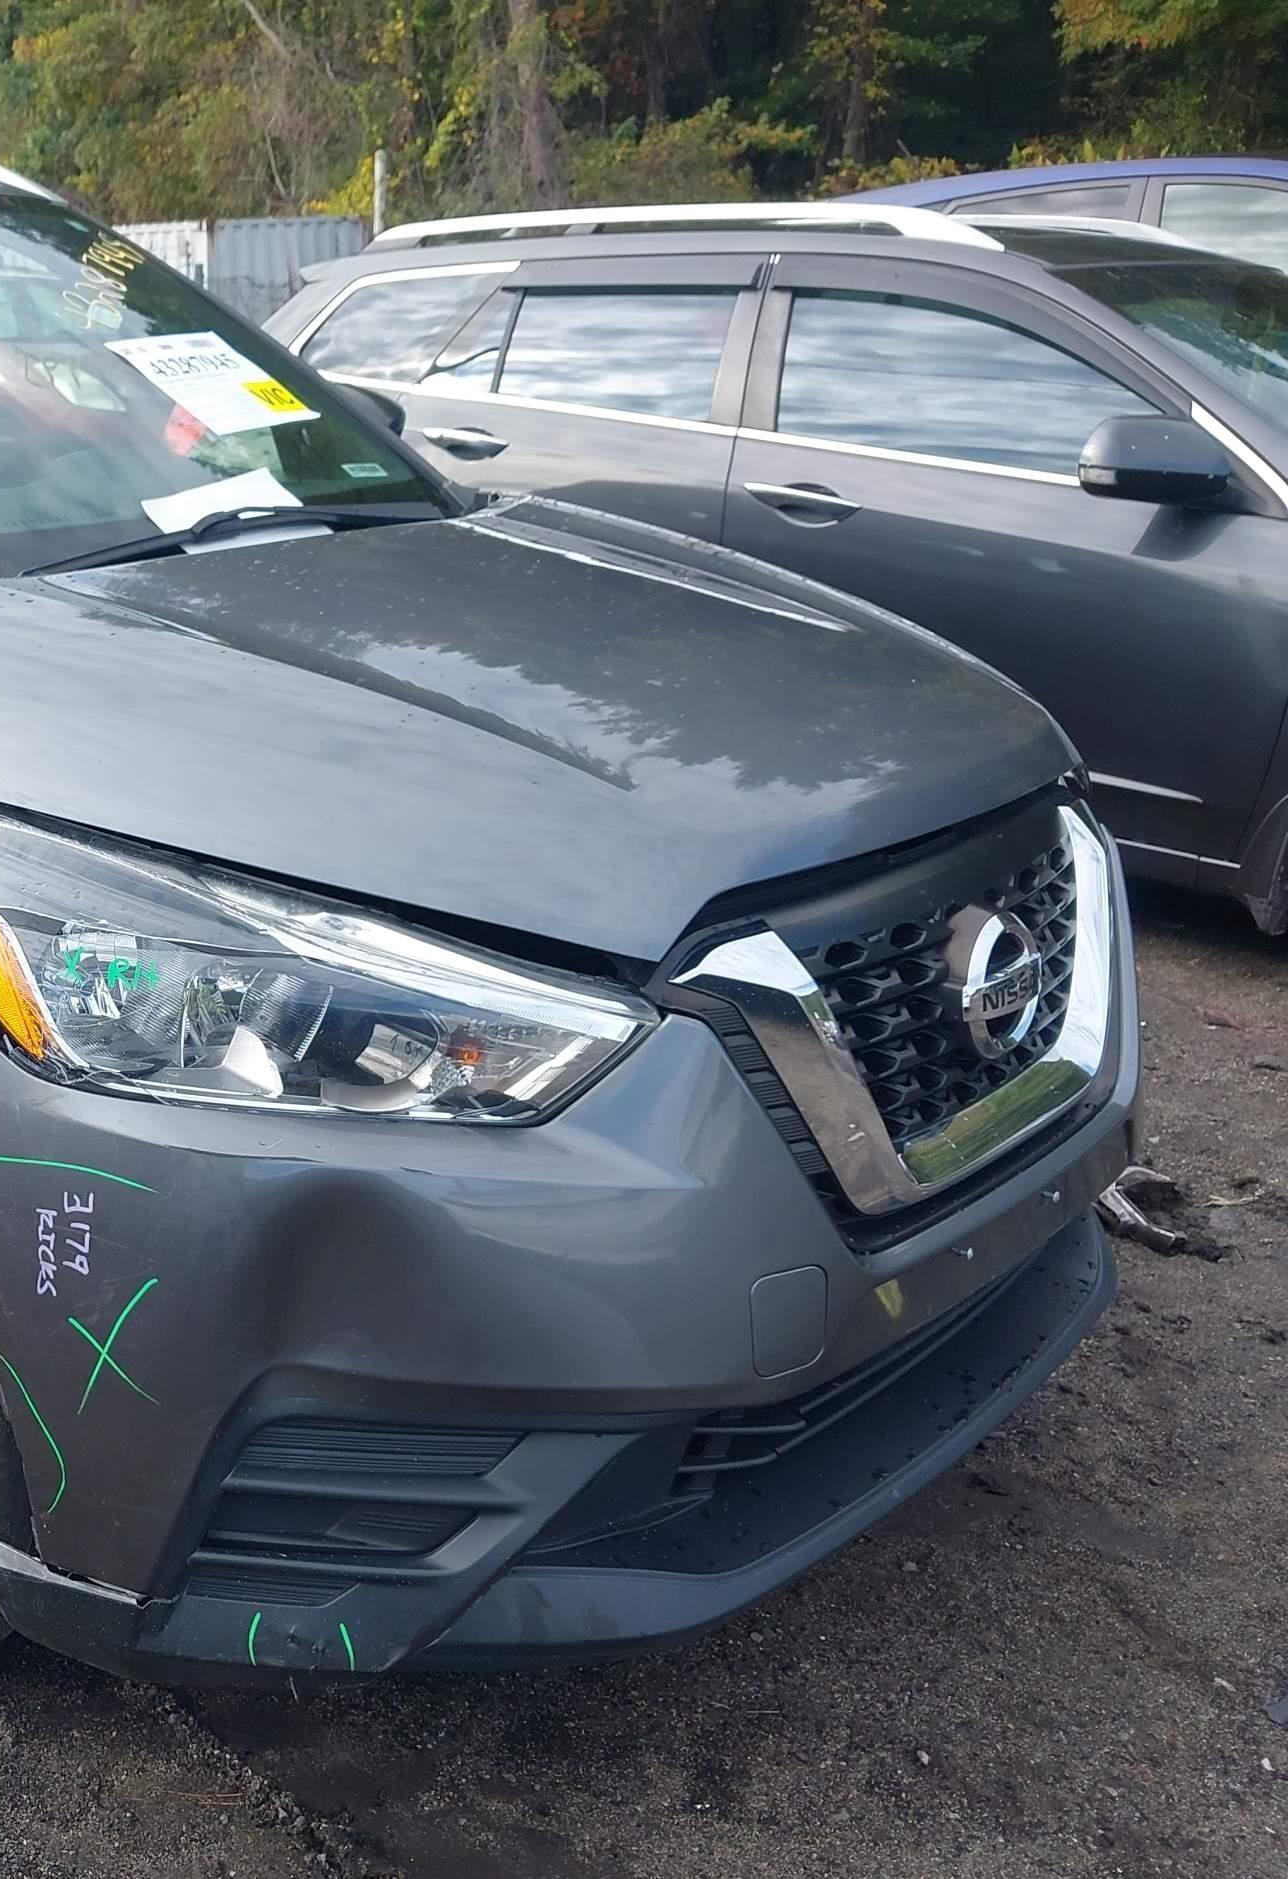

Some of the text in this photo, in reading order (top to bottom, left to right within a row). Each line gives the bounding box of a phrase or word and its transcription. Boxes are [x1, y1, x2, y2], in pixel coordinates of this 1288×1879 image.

[149, 353, 240, 377] 43287945
[983, 972, 1039, 1012] NISS
[35, 1208, 58, 1297] KICKS
[62, 1191, 94, 1276] 3179
